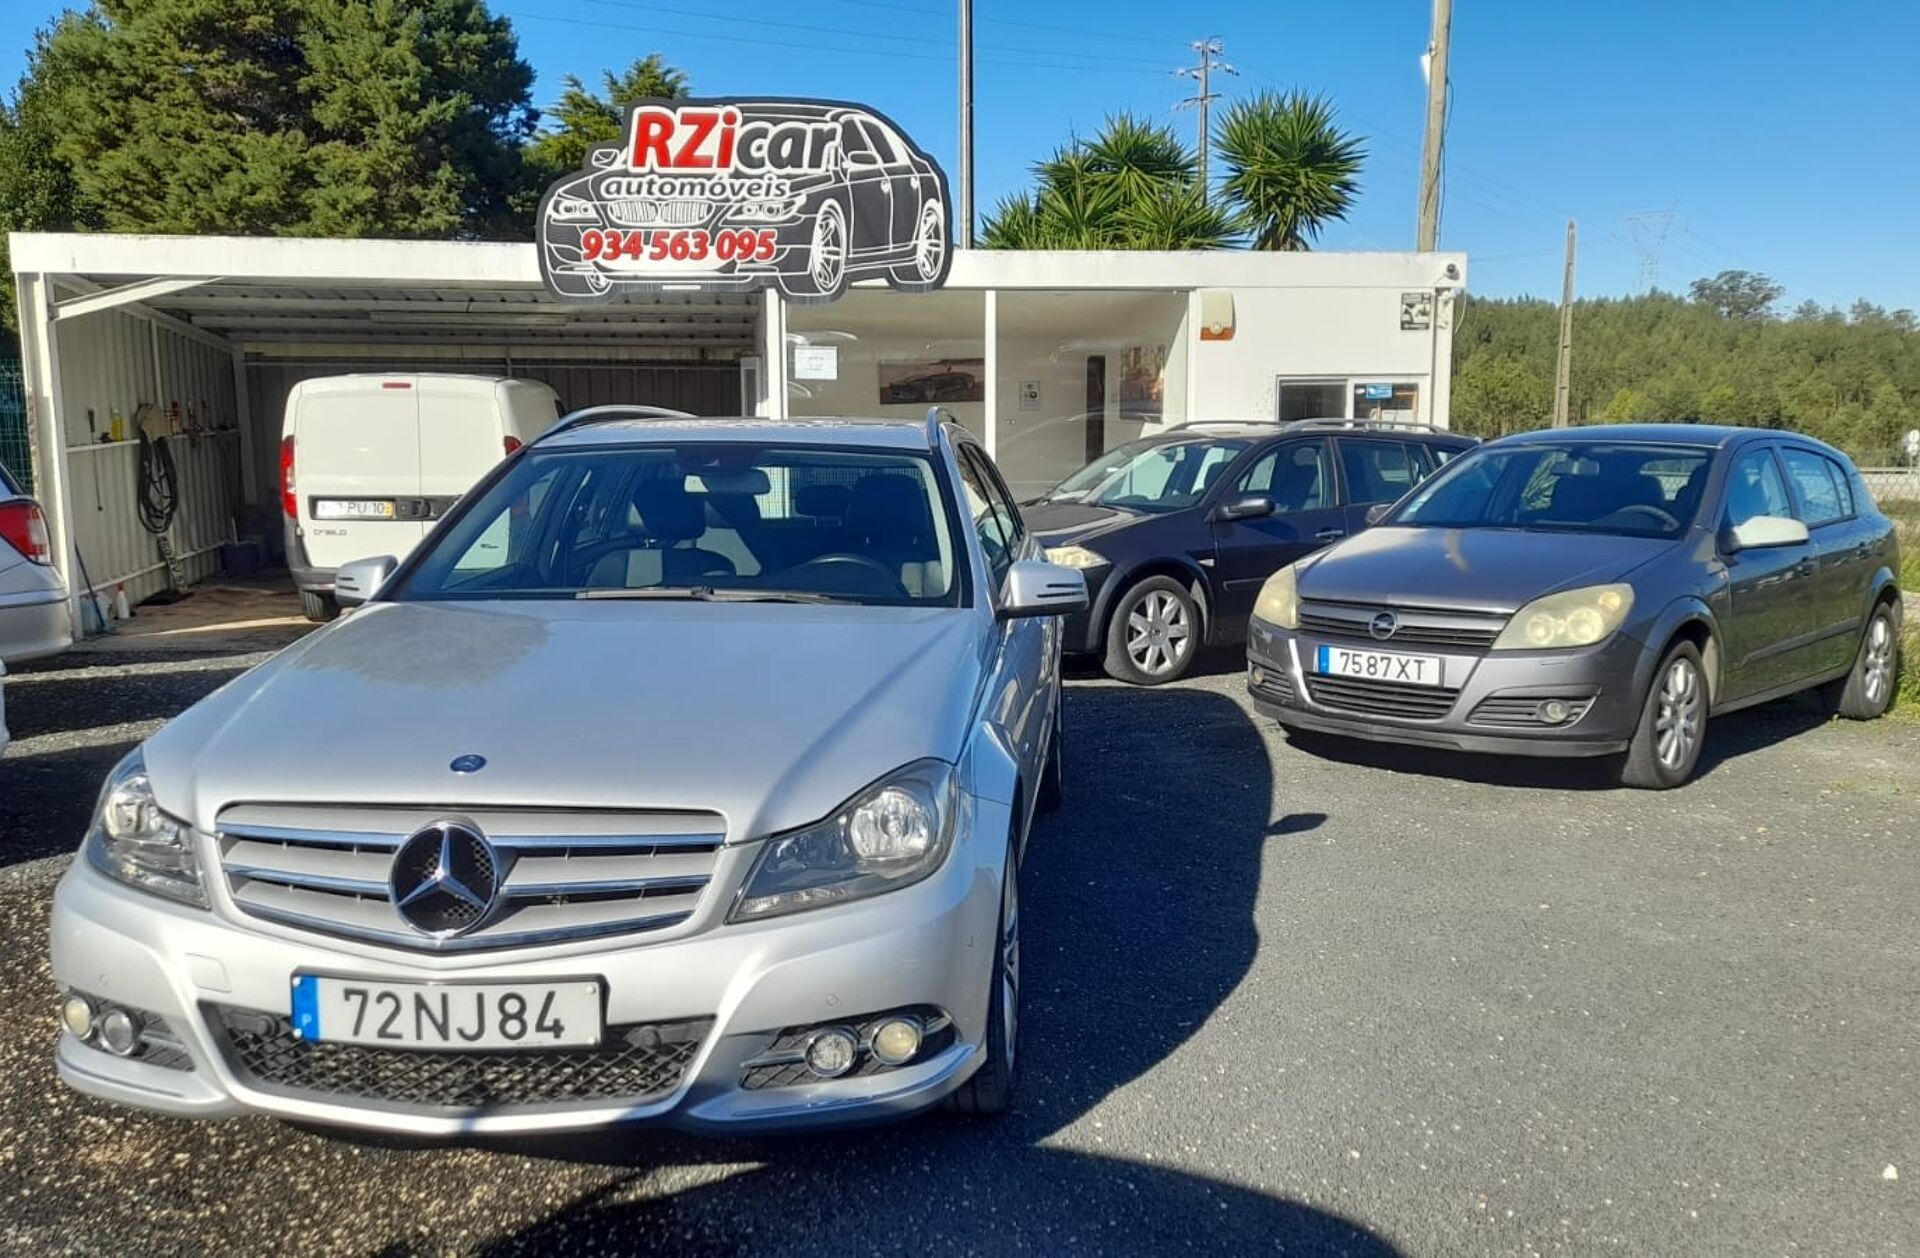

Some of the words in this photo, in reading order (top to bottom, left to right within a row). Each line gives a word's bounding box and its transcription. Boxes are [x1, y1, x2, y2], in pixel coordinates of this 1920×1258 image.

[631, 109, 839, 169] RZicar
[604, 174, 788, 198] automóveis
[582, 231, 644, 260] 934
[649, 231, 709, 260] 563
[716, 231, 776, 260] 095
[343, 987, 566, 1041] 72NJ84
